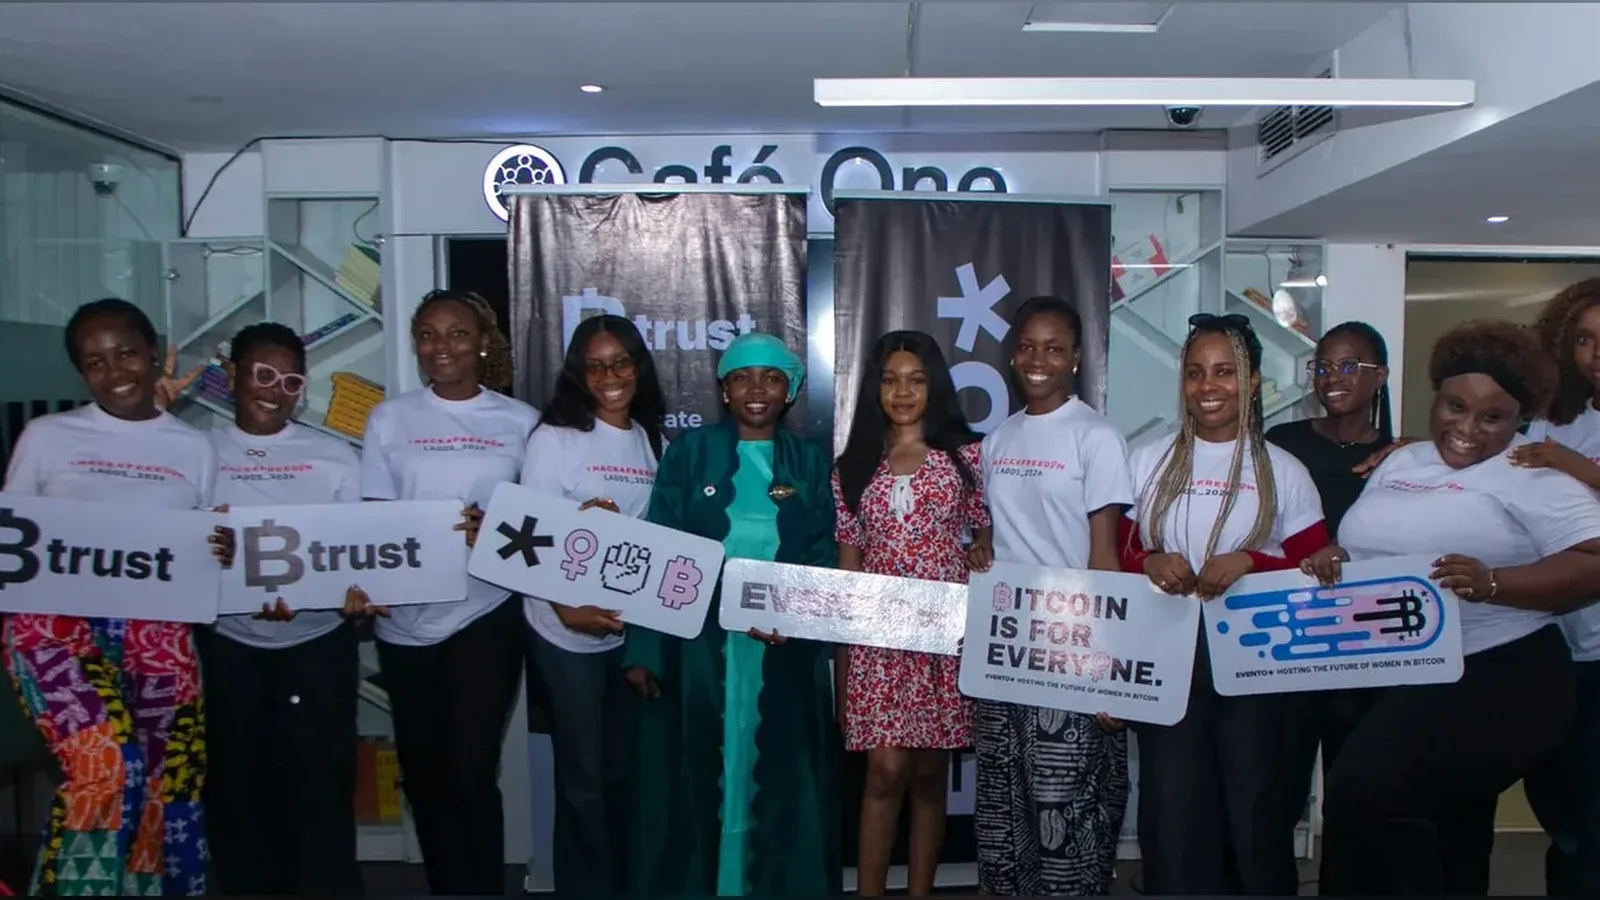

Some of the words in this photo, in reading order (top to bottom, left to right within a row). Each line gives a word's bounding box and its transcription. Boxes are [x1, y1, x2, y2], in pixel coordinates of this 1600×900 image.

[990, 615, 1018, 639] IS
[1029, 619, 1091, 648] FOR
[1276, 666, 1312, 676] HOSTING
[1312, 664, 1328, 672] THE
[1330, 662, 1358, 671] FUTURE
[1360, 661, 1370, 670] OF
[1371, 660, 1401, 669] WOMEN
[1403, 659, 1411, 667] IN
[1413, 657, 1445, 666] BITCOIN
[1047, 680, 1059, 689] THE
[1061, 683, 1086, 693] FUTURE
[1098, 688, 1122, 698] WOMEN
[1132, 693, 1159, 702] BITCOIN
